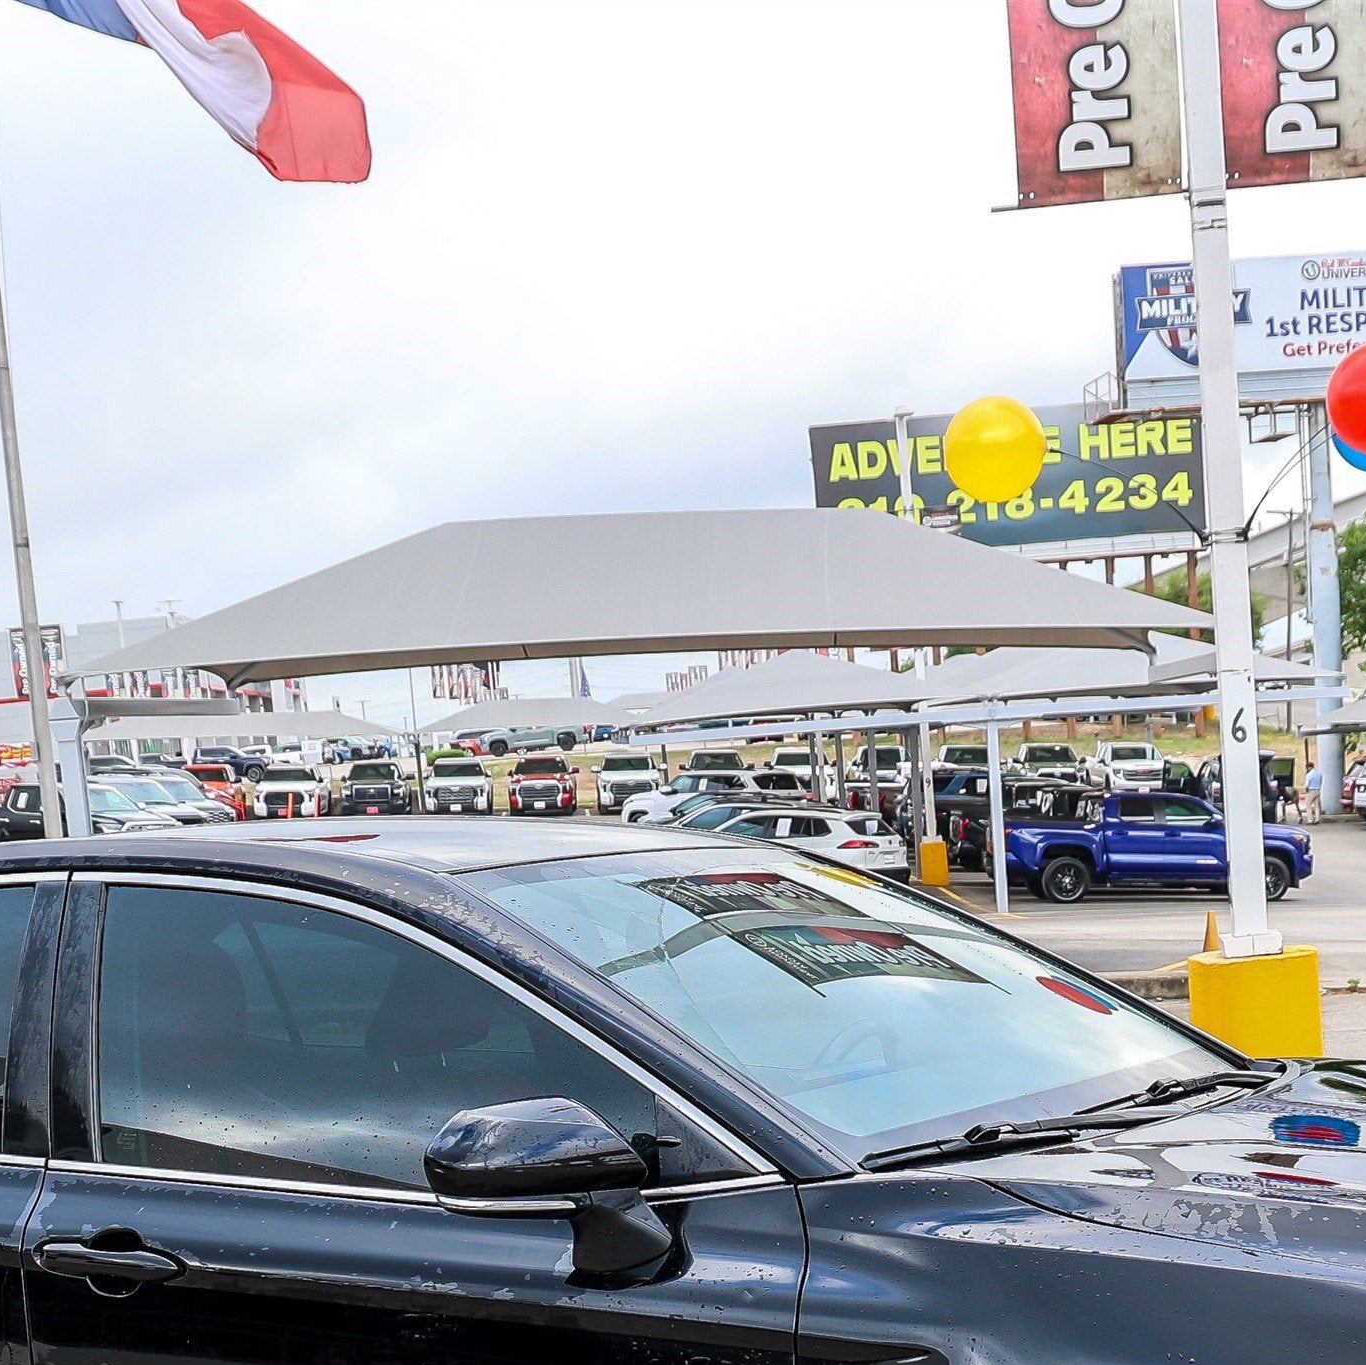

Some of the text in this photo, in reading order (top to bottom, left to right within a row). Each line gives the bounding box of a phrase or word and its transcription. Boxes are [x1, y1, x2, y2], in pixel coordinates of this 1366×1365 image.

[1059, 43, 1131, 173] Pre
[1265, 25, 1339, 155] Pre
[1265, 314, 1301, 338] 1st
[1282, 341, 1314, 358] Get
[1078, 418, 1194, 462] HERE
[1231, 706, 1248, 743] 6
